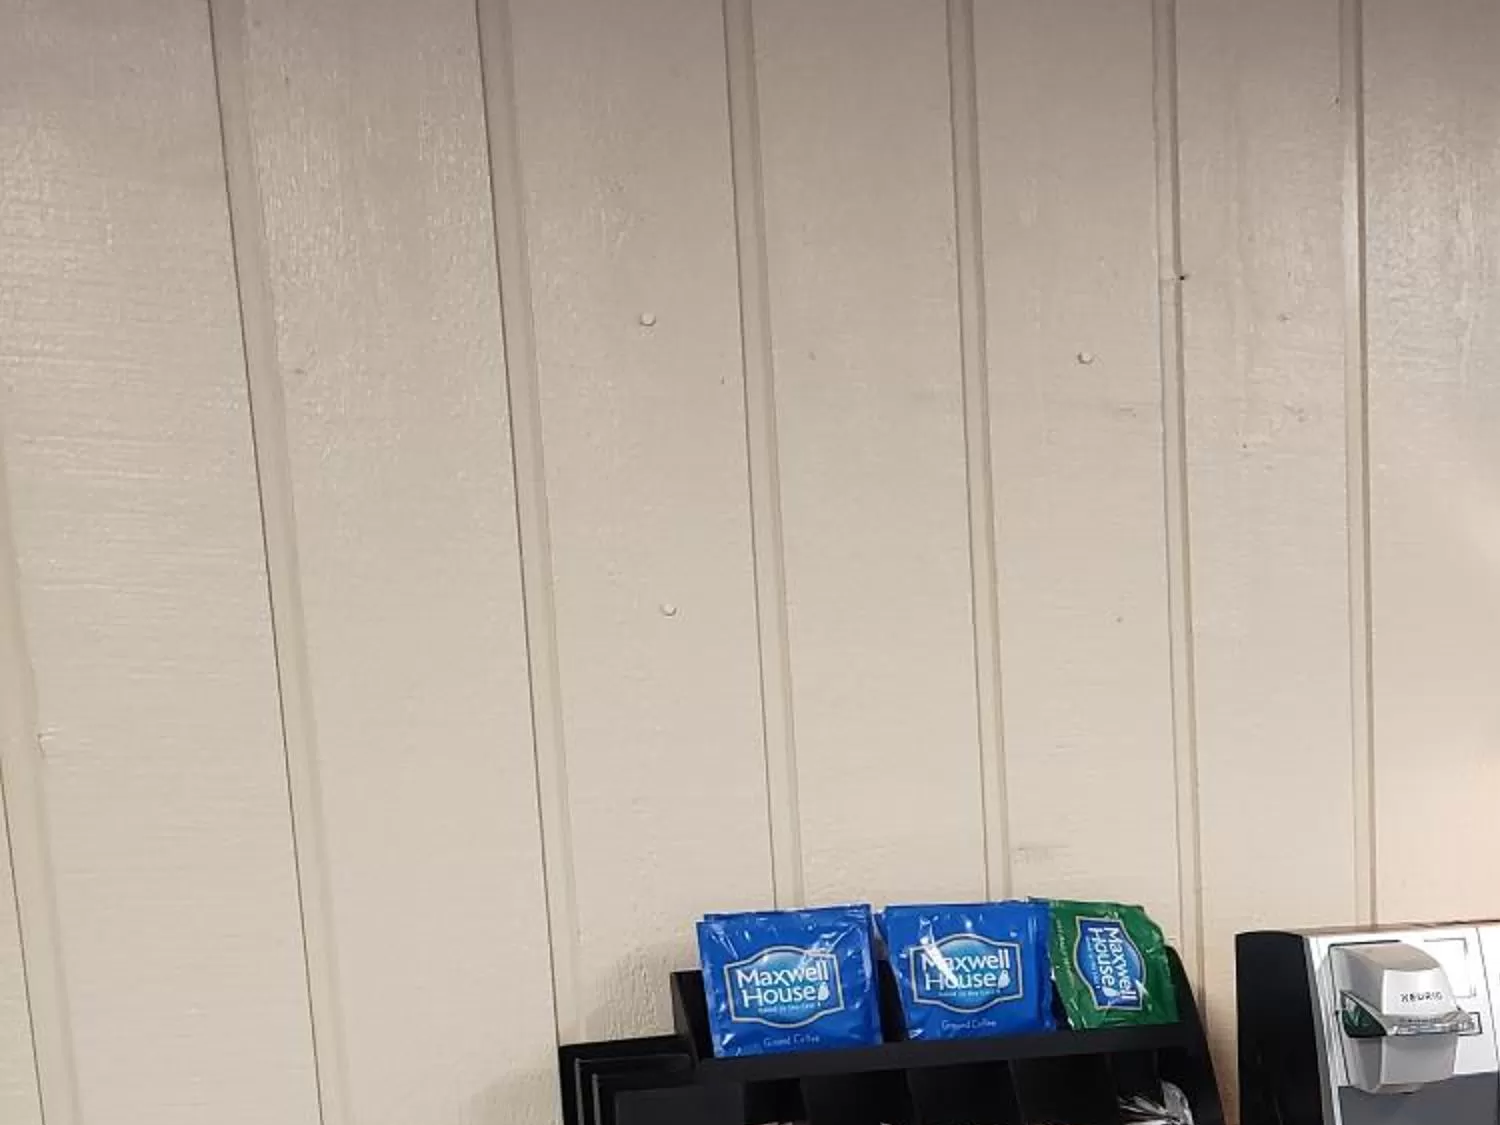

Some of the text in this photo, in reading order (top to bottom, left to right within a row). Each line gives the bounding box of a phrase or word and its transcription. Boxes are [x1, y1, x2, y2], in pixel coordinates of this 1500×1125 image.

[920, 948, 1011, 973] Maxwell
[1087, 926, 1116, 987] House
[1103, 926, 1137, 1000] Maxwell
[735, 958, 830, 989] Maxwell
[925, 971, 998, 991] House
[741, 984, 817, 1008] House
[1400, 991, 1443, 1003] KEURIG
